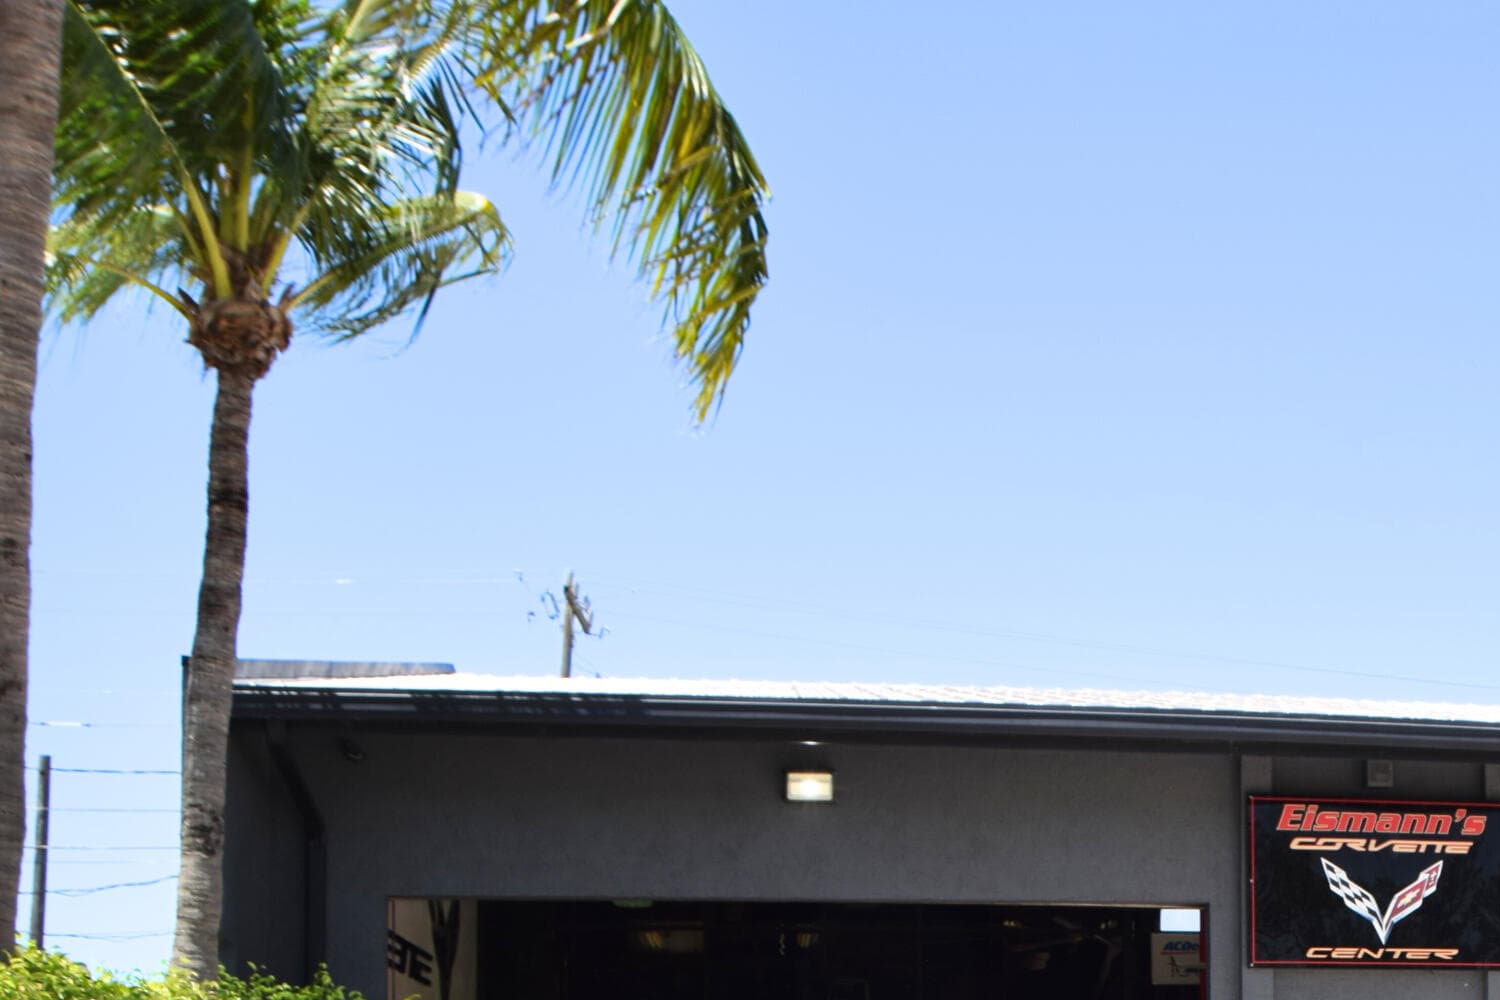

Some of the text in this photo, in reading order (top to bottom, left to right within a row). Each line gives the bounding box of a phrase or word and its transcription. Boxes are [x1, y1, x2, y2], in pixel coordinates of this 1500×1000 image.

[1276, 804, 1487, 836] Eismann's
[1289, 837, 1474, 854] CORVETTE
[1305, 947, 1459, 960] CENTER
